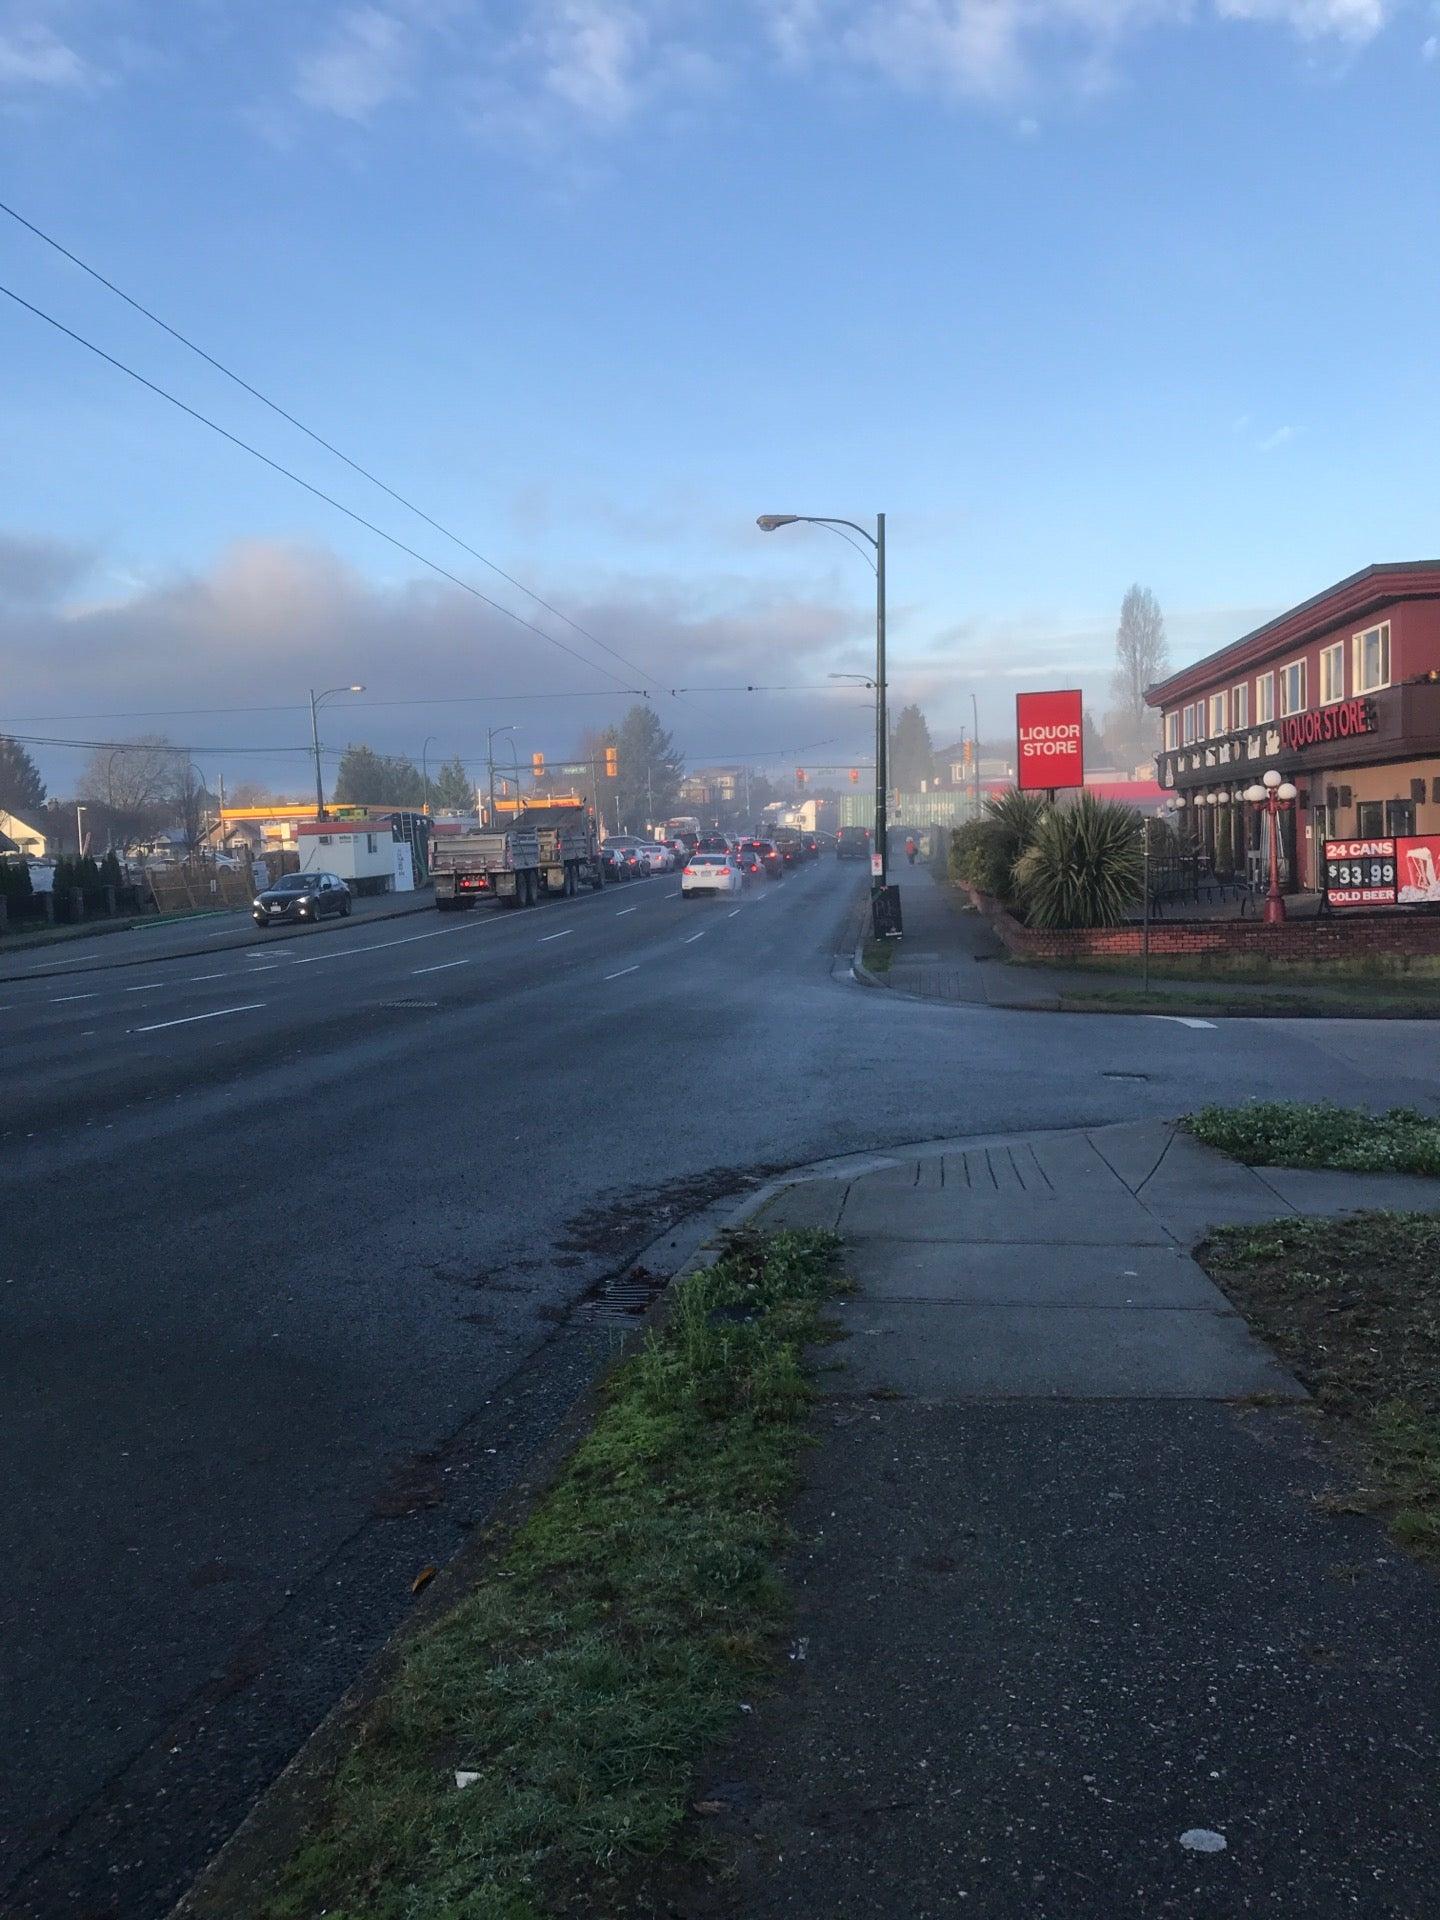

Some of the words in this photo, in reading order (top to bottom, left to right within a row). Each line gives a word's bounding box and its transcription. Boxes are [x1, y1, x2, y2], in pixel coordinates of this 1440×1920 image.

[1280, 711, 1322, 751] LIQUOR
[1324, 696, 1367, 739] STORE
[1020, 725, 1080, 741] LIQUOR
[1023, 741, 1077, 756] STORE
[1327, 845, 1347, 857] 24
[1349, 842, 1393, 856] CANS
[1328, 864, 1394, 884] $33.99
[1328, 892, 1361, 902] COLD
[1362, 889, 1395, 900] BEER
